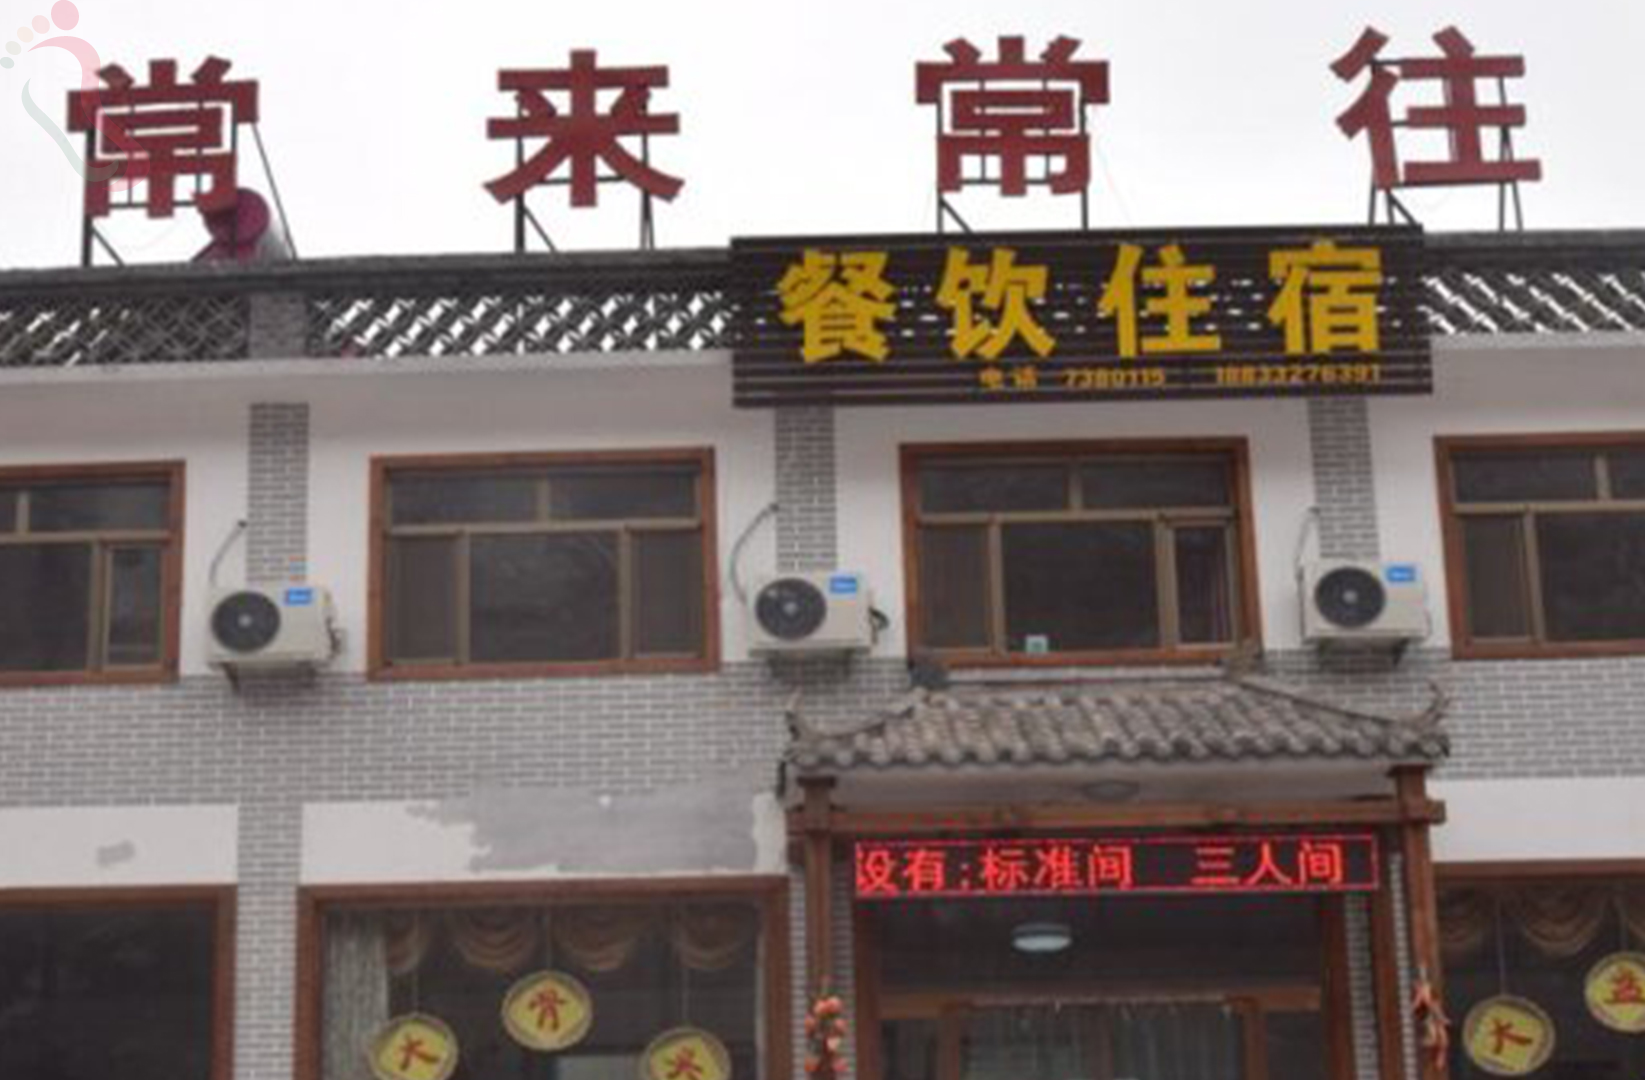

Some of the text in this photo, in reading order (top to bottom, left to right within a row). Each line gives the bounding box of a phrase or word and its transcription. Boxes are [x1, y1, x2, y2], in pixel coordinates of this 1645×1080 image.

[66, 27, 1541, 218] 常来常往
[777, 240, 1383, 363] 餐饮住宿
[1191, 841, 1343, 885] 三人间
